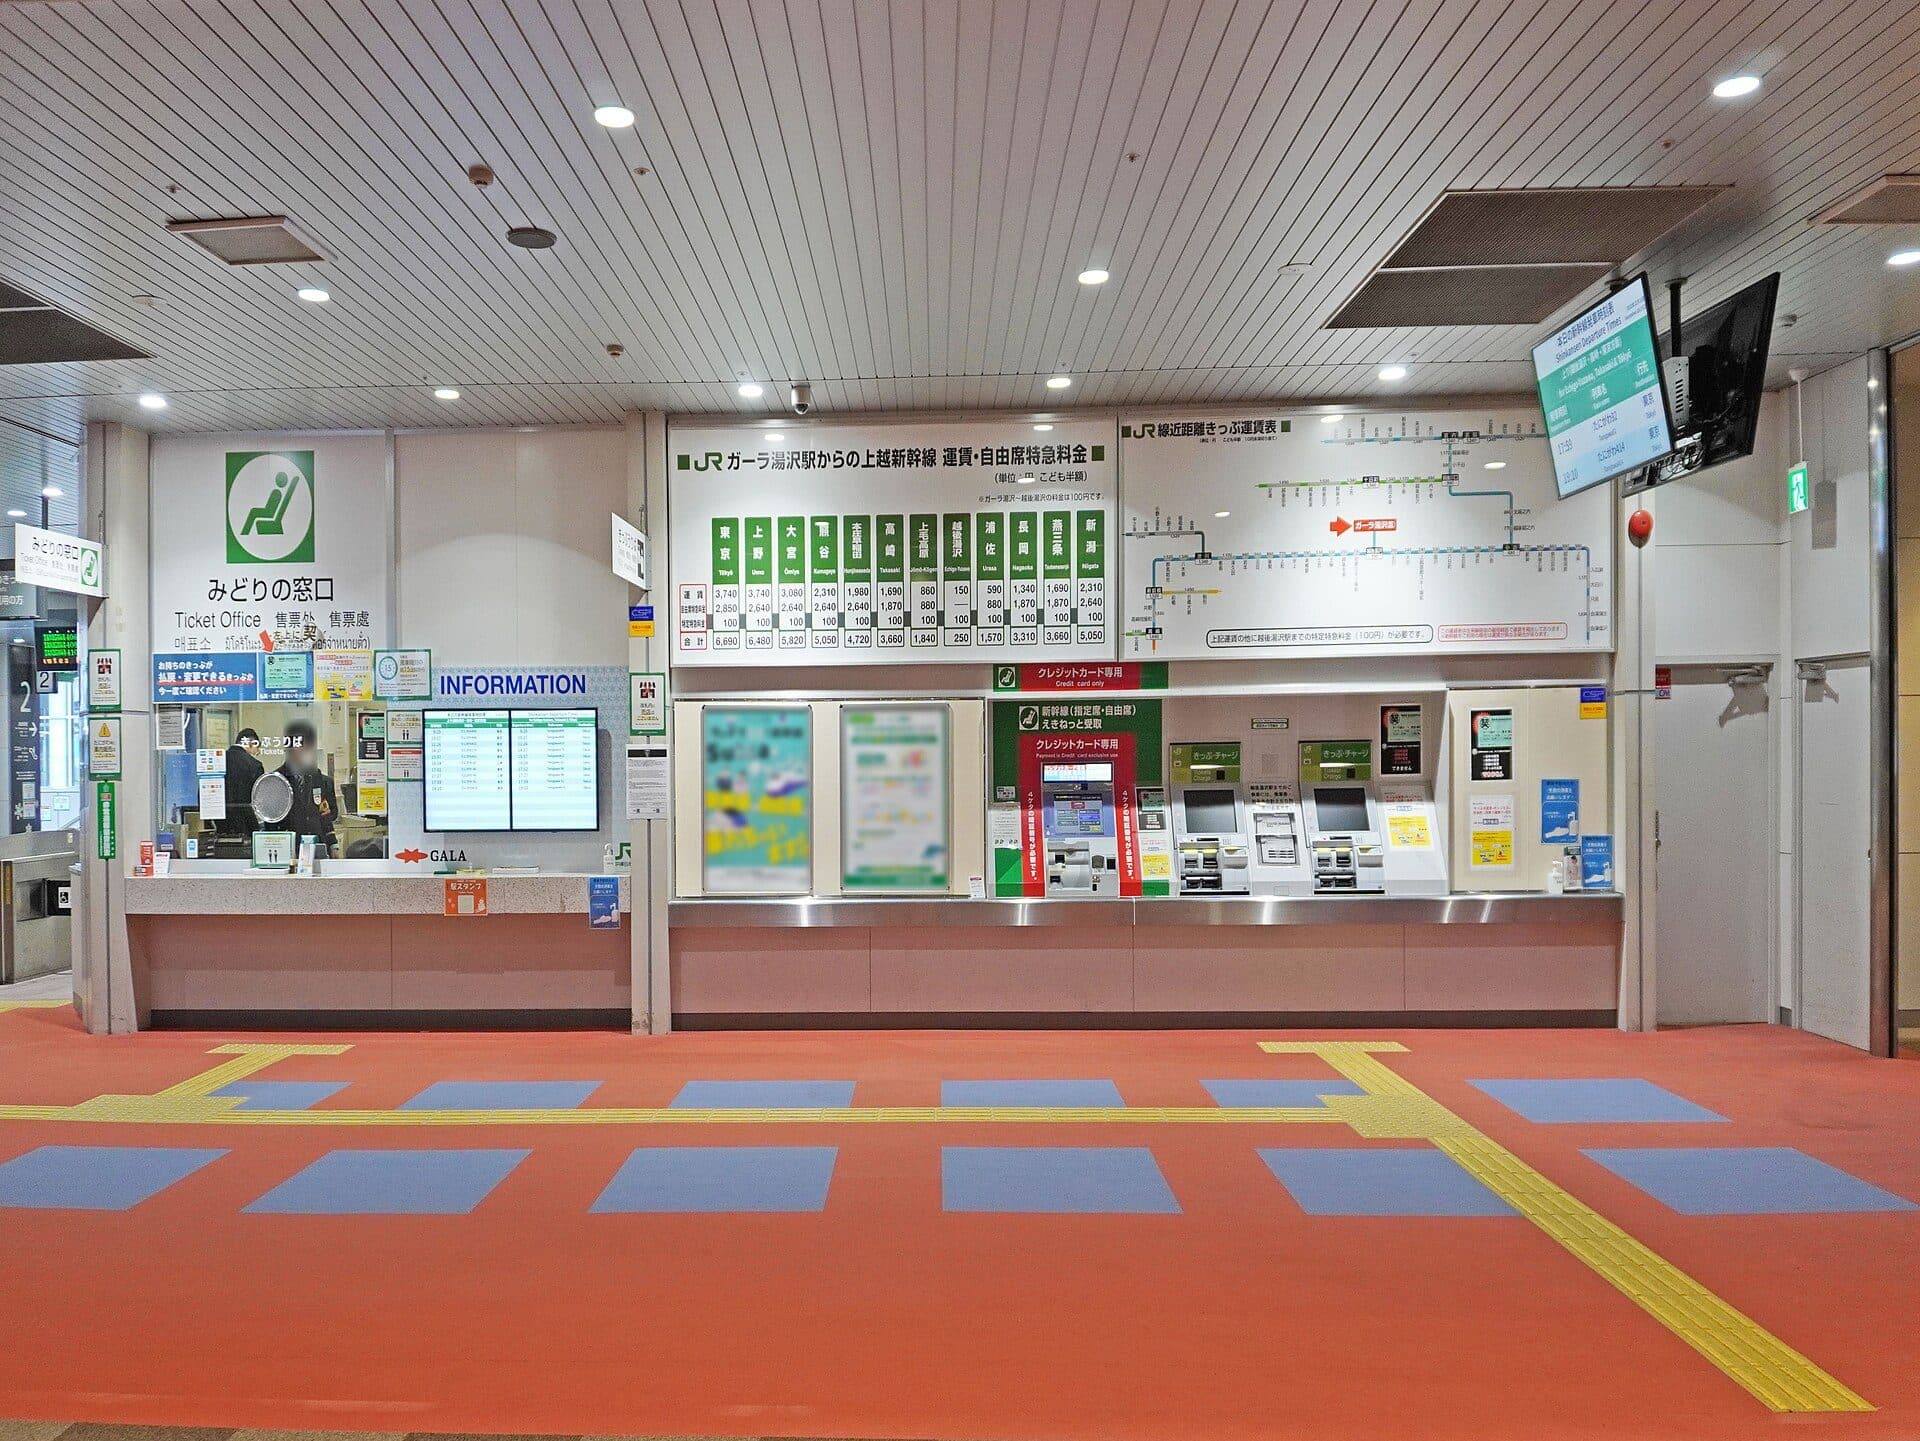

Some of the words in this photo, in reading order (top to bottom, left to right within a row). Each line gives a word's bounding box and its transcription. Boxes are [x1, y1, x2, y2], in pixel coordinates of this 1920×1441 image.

[1582, 328, 1607, 349] Departure
[1606, 318, 1623, 332] Times
[1133, 424, 1156, 439] JR
[1157, 420, 1277, 438] 線近距離きっぷ運賃表
[694, 452, 723, 472] JR
[727, 448, 937, 472] ガーラ湯沢駅からの上越新幹線
[942, 444, 1088, 467] 運賃・自由席特急料金
[884, 522, 896, 557] 高崎
[918, 521, 929, 558] 上毛高原
[951, 521, 963, 557] 越後湯沢
[984, 521, 996, 555] 浦佐
[1018, 520, 1029, 555] 長岡
[1051, 519, 1063, 555] 燕三条
[1085, 518, 1097, 554] 新潟
[719, 526, 731, 560] 東京
[752, 525, 764, 560] 上野
[785, 524, 797, 559] 大宮
[207, 577, 334, 602] みどりの窓口
[814, 588, 836, 596] 2,310
[847, 588, 869, 596] 1,980
[881, 587, 902, 596] 1,690
[920, 586, 935, 595] 860
[954, 586, 969, 594] 150
[987, 585, 1002, 594] 590
[1014, 584, 1035, 594] 1,340
[1047, 584, 1068, 594] 1,690
[1080, 583, 1102, 593] 2,310
[715, 590, 737, 598] 3,740
[748, 590, 770, 598] 3,740
[748, 604, 770, 612] 2,640
[781, 603, 803, 612] 2,640
[814, 602, 836, 612] 2,640
[848, 602, 870, 611] 2,640
[881, 602, 902, 611] 1,870
[920, 601, 936, 610] 880
[987, 600, 1002, 608] 880
[1014, 599, 1036, 609] 1,870
[1047, 598, 1068, 608] 1,870
[1080, 598, 1102, 608] 2,640
[716, 604, 738, 613] 2,850
[175, 611, 216, 629] Ticket
[220, 610, 261, 629] Office
[329, 611, 370, 628] 售票處
[856, 616, 870, 626] 100
[888, 616, 902, 625] 100
[921, 616, 936, 624] 100
[954, 615, 969, 624] 100
[988, 614, 1002, 623] 100
[1021, 614, 1036, 622] 100
[1054, 614, 1069, 622] 100
[1088, 612, 1102, 621] 100
[724, 619, 738, 628] 100
[756, 618, 770, 627] 100
[790, 618, 804, 626] 100
[822, 618, 836, 626] 100
[748, 636, 770, 646] 6,480
[781, 636, 804, 645] 5,820
[814, 636, 837, 644] 5,050
[848, 635, 870, 644] 4,720
[881, 634, 902, 644] 3,660
[914, 634, 936, 643] 1,840
[954, 634, 969, 642] 250
[980, 633, 1002, 642] 1,570
[1014, 632, 1036, 642] 3,310
[1046, 632, 1069, 642] 3,660
[1080, 631, 1103, 641] 5,050
[174, 636, 212, 652] 매표소
[684, 638, 704, 646] 合計
[716, 637, 738, 646] 6,690
[158, 661, 213, 670] お持ちのきっぷが
[1038, 667, 1123, 678] クレジットカード専用
[40, 672, 49, 688] 2
[440, 674, 587, 695] INFORMATION
[1091, 680, 1104, 688] only
[158, 686, 227, 696] 今一度ご確認ください
[20, 681, 31, 713] 2
[1042, 704, 1137, 717] 新幹線（指定席・自由席）
[1042, 718, 1102, 730] えきねっと受取
[240, 736, 304, 748] きっぷうりば
[1036, 739, 1119, 750] クレジットカード専用
[1193, 752, 1238, 760] きっぷ・チャージ
[1323, 750, 1369, 759] きっぷ・チャージ
[431, 850, 467, 862] GALA
